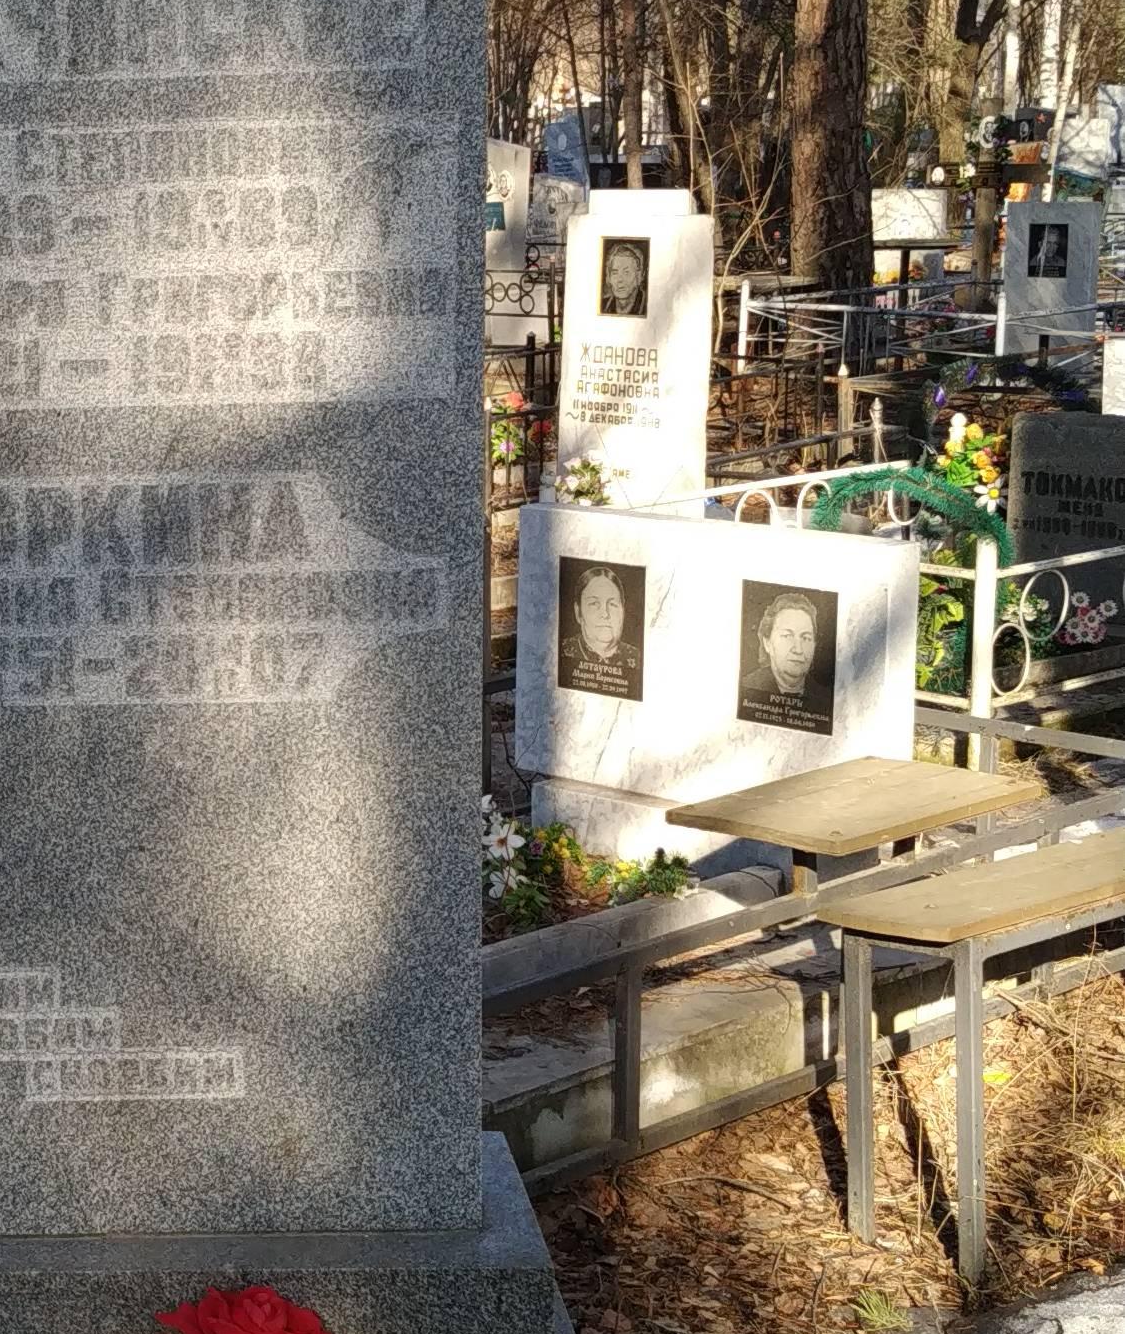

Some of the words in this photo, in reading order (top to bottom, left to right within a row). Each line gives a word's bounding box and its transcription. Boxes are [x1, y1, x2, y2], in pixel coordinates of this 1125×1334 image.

[580, 343, 658, 367] ЖДАНОВА
[581, 365, 659, 384] АНАСТАСИЯ
[576, 380, 660, 398] АГАФОНОВНА
[32, 1058, 236, 1091] СКОРБИМ
